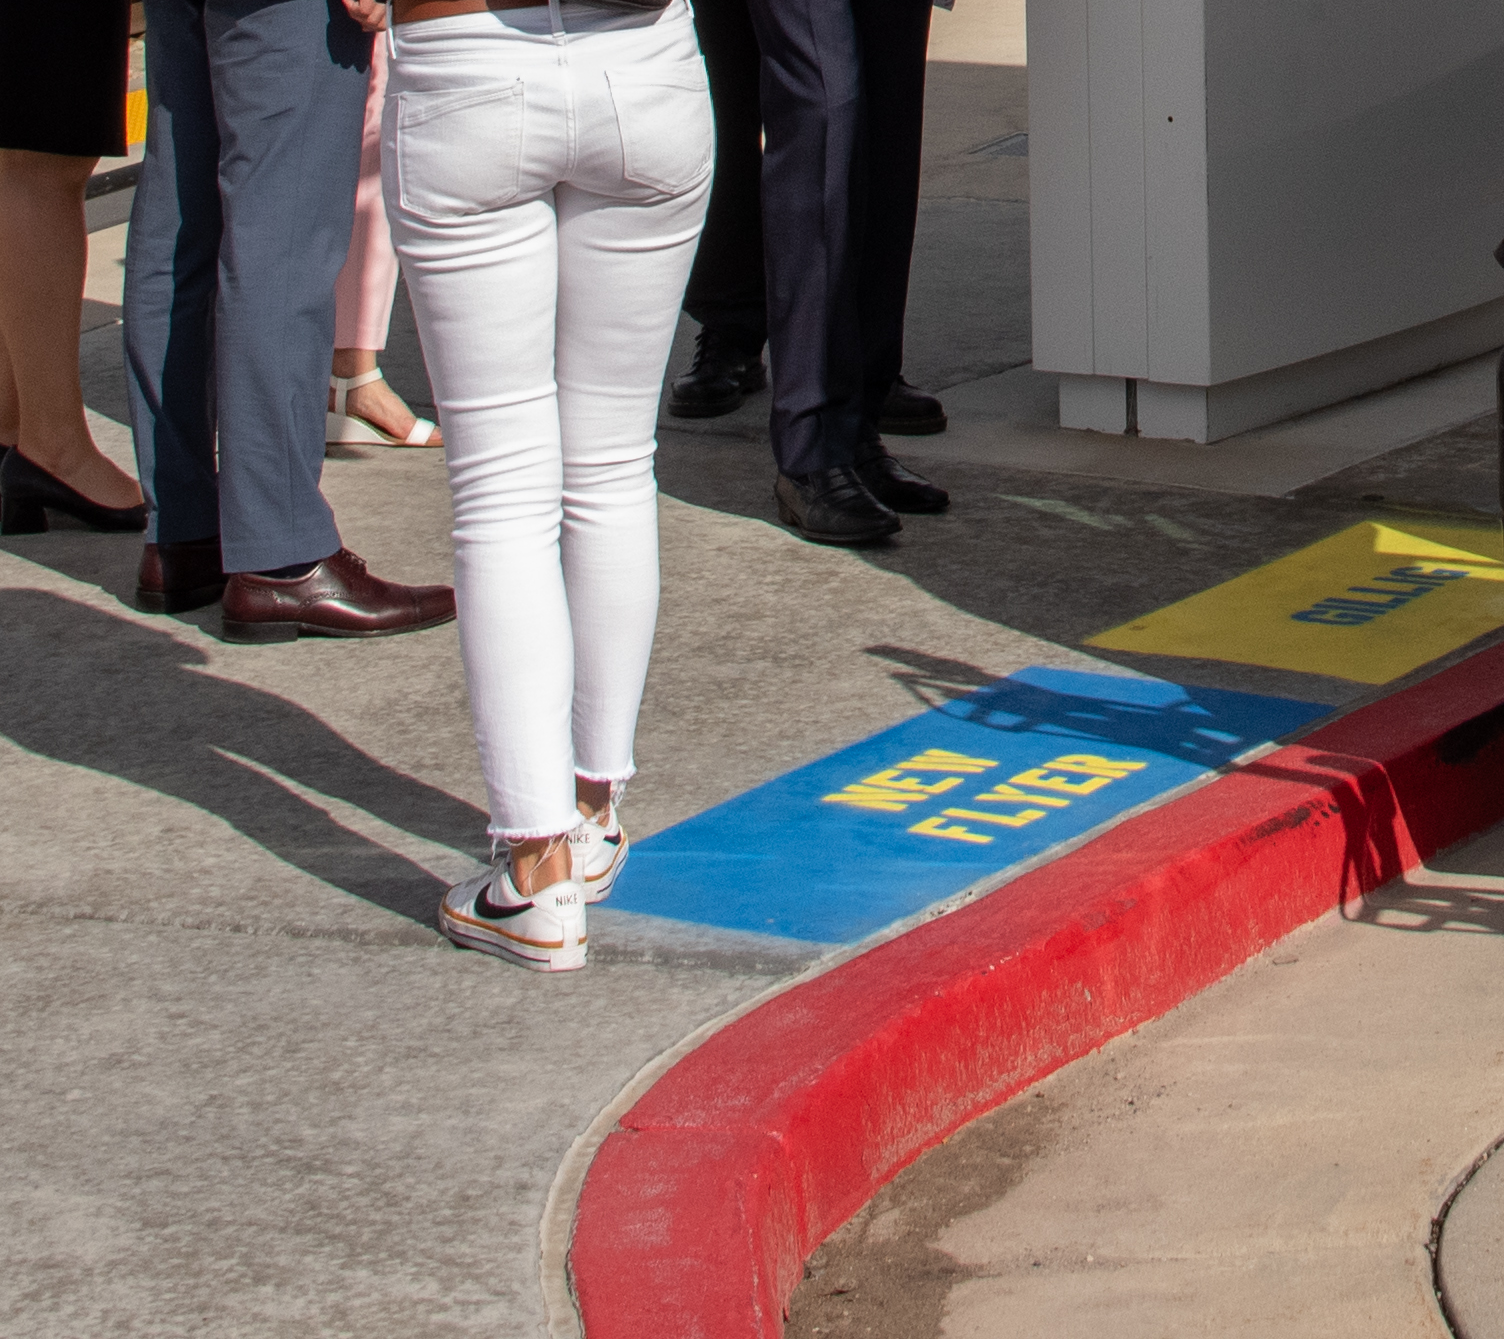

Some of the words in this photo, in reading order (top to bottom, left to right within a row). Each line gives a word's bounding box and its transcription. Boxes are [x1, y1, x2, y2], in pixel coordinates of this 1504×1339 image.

[1290, 566, 1470, 627] GILLIG
[821, 748, 1000, 812] NEW
[906, 754, 1147, 845] FLYER
[566, 833, 590, 844] NIKE
[556, 893, 578, 907] NIKE
